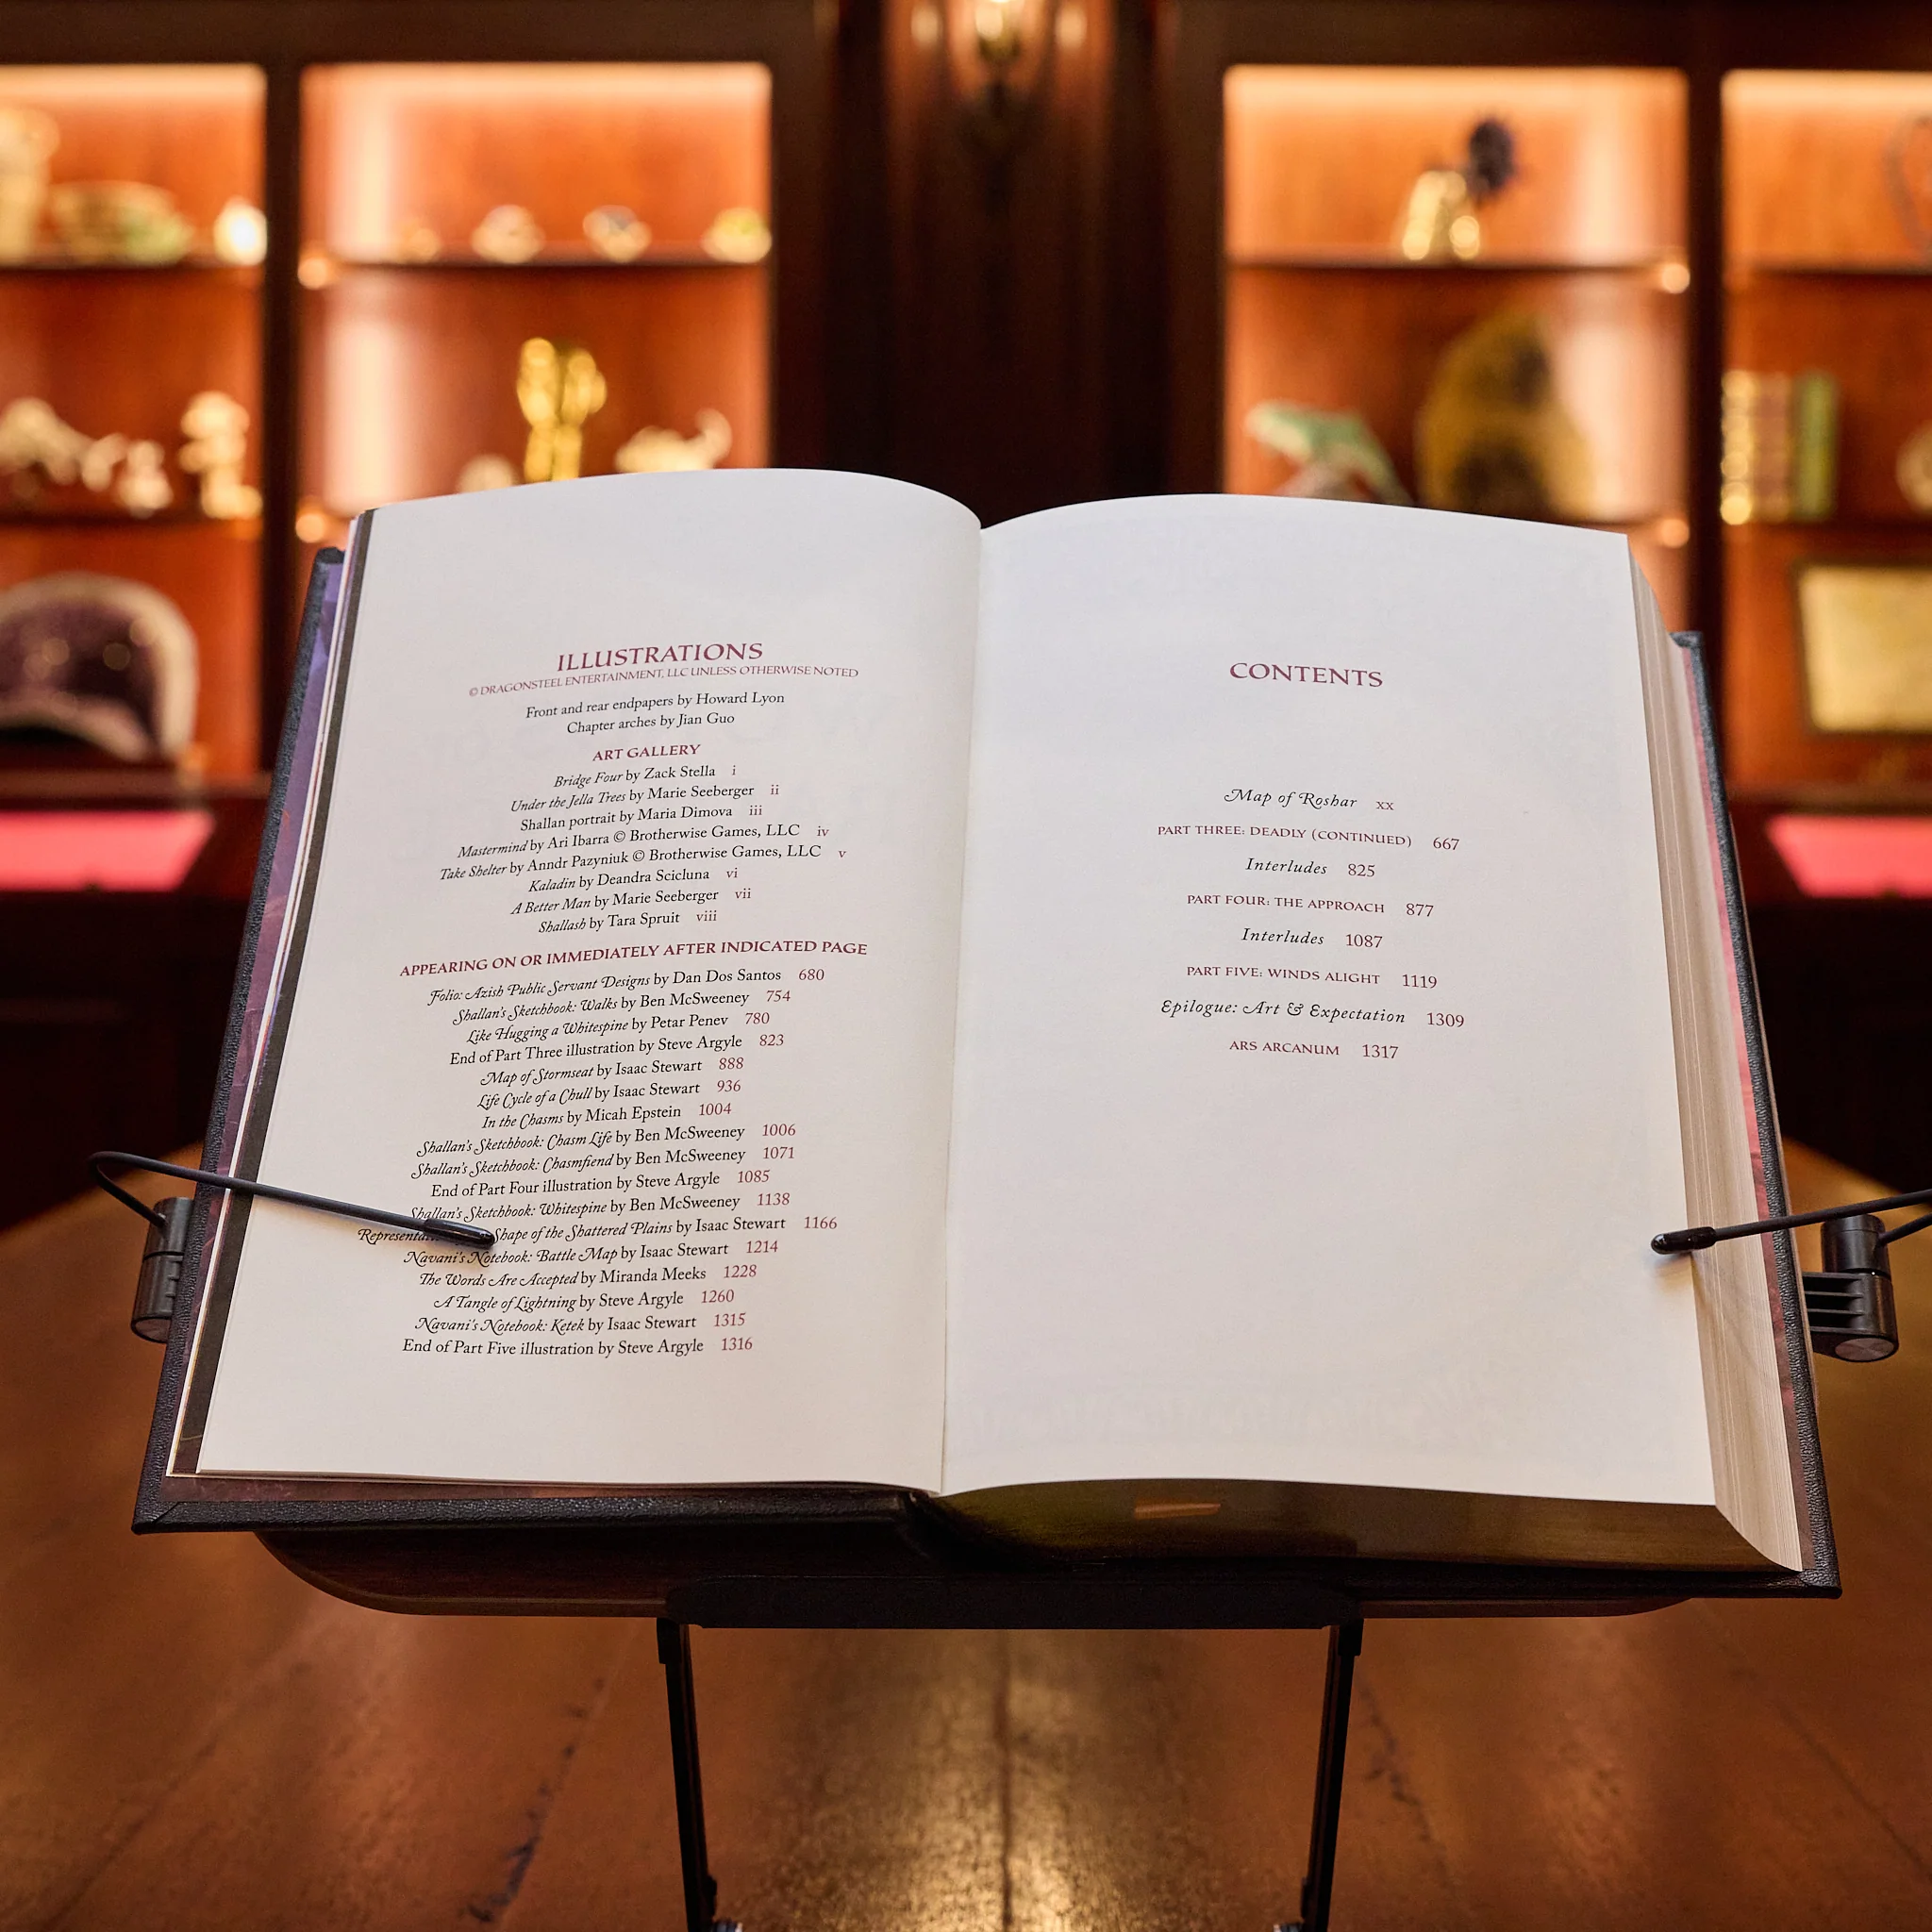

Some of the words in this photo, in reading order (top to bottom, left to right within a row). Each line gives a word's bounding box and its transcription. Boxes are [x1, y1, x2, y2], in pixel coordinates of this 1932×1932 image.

[557, 642, 763, 673] ILLUSTRATIONS
[480, 677, 563, 695] DRAGONSTEEL
[565, 669, 661, 686] ENTERTAINMENT,
[667, 668, 687, 677] LLC
[691, 666, 737, 676] UNLESS
[739, 665, 811, 675] OTHERWISE
[813, 666, 859, 677] NOTED
[1229, 662, 1383, 688] CONTENTS
[525, 706, 558, 719] Front
[560, 701, 583, 715] and
[586, 703, 610, 713] rear
[612, 696, 674, 712] endpapers
[676, 693, 693, 709] by
[695, 691, 748, 705] Howard
[751, 691, 785, 707] Lyon
[566, 721, 616, 736] Chapter
[618, 715, 657, 729] arches
[659, 714, 675, 730] by
[675, 712, 703, 728] Jian
[706, 711, 735, 724] Guo
[591, 748, 625, 762] ART
[626, 743, 702, 758] GALLERY
[553, 774, 592, 790] Bridge
[592, 771, 625, 784] Four
[625, 769, 641, 785] by
[643, 766, 676, 780] Zack
[679, 764, 716, 778] Stella
[731, 764, 736, 776] i
[510, 798, 547, 812] Under
[548, 795, 567, 808] the
[565, 792, 594, 809] Jella
[597, 791, 626, 804] Trees
[629, 789, 645, 805] by
[646, 786, 687, 800] Marie
[691, 784, 755, 800] Seeberger
[770, 784, 779, 795] ii
[1224, 788, 1273, 808] Map
[1277, 791, 1297, 808] of
[1298, 791, 1357, 810] Roshar
[1375, 801, 1394, 811] xx
[520, 816, 566, 832] Shallan
[568, 811, 617, 831] portrait
[619, 809, 635, 825] by
[636, 808, 677, 821] Maria
[679, 806, 733, 819] Dimova
[748, 804, 762, 816] iii
[1158, 824, 1191, 836] PART
[1194, 824, 1245, 836] THREE:
[1250, 826, 1307, 839] DEADLY
[1311, 828, 1412, 848] (CONTINUED)
[1432, 836, 1460, 851] 667
[527, 876, 576, 892] Kaladin
[578, 874, 595, 891] by
[596, 870, 652, 887] Deandra
[655, 868, 710, 882] Scicluna
[725, 867, 738, 878] vi
[1244, 857, 1328, 874] Interludes
[1347, 863, 1375, 877] 825
[1187, 894, 1222, 905] PART
[1224, 894, 1270, 906] FOUR:
[1274, 896, 1304, 908] THE
[1307, 899, 1385, 913] APPROACH
[1406, 902, 1435, 918] 877
[538, 917, 587, 934] Shallash
[589, 916, 605, 933] by
[607, 913, 636, 927] Tara
[640, 911, 681, 929] Spruit
[695, 909, 717, 922] viii
[1241, 927, 1324, 945] Interludes
[1345, 933, 1383, 949] 1087
[399, 958, 489, 977] APPEARING
[491, 956, 517, 970] ON
[520, 954, 542, 967] OR
[546, 944, 660, 965] IMMEDIATELY
[662, 941, 717, 957] AFTER
[720, 940, 818, 954] INDICATED
[821, 941, 868, 956] PAGE
[426, 988, 463, 1007] Folio:
[464, 984, 505, 1001] Azish
[507, 981, 546, 996] Public
[546, 978, 598, 997] Servant
[600, 974, 651, 991] Designs
[653, 972, 670, 989] by
[672, 971, 702, 985] Dan
[705, 969, 733, 983] Dos
[737, 968, 782, 982] Santos
[798, 968, 825, 981] 680
[1187, 966, 1222, 976] PART
[1225, 966, 1263, 977] FIVE:
[1267, 968, 1321, 981] WINDS
[1324, 972, 1381, 985] ALIGHT
[1402, 974, 1438, 990] 1119
[452, 1006, 508, 1026] Shallan's
[507, 1000, 577, 1022] Sketchbook:
[579, 997, 619, 1012] Walks
[621, 995, 638, 1013] by
[639, 994, 666, 1008] Ben
[668, 991, 750, 1008] McSweeney
[766, 989, 791, 1003] 754
[1160, 999, 1238, 1019] Epilogue:
[1241, 1000, 1281, 1015] Art
[1286, 1002, 1305, 1017] &
[1309, 1003, 1406, 1024] Expectation
[1426, 1011, 1465, 1028] 1309
[449, 1050, 476, 1065] End
[478, 1049, 495, 1063] of
[493, 1048, 523, 1062] Part
[525, 1045, 563, 1060] Three
[565, 1041, 635, 1057] illustration
[639, 1039, 656, 1056] by
[658, 1037, 693, 1051] Steve
[695, 1034, 742, 1053] Argyle
[758, 1033, 784, 1047] 823
[1228, 1041, 1257, 1051] ARS
[1262, 1041, 1340, 1056] ARCANUM
[1361, 1043, 1399, 1059] 1317
[480, 1115, 496, 1129] In
[498, 1114, 518, 1128] the
[519, 1112, 565, 1130] Chasms
[566, 1109, 583, 1127] by
[584, 1107, 627, 1123] Micah
[630, 1105, 681, 1124] Epstein
[698, 1102, 732, 1116] 1004
[419, 1272, 442, 1286] The
[444, 1273, 487, 1287] Words
[488, 1273, 518, 1287] Are
[519, 1271, 580, 1291] Accepted
[580, 1270, 597, 1289] by
[598, 1267, 658, 1284] Miranda
[660, 1265, 707, 1281] Meeks
[724, 1263, 758, 1279] 1228
[433, 1295, 457, 1308] A
[456, 1294, 499, 1314] Tangle
[500, 1295, 518, 1314] of
[513, 1295, 577, 1314] Lightning
[579, 1293, 596, 1312] by
[598, 1292, 635, 1307] Steve
[637, 1291, 684, 1310] Argyle
[701, 1289, 735, 1304] 1260
[401, 1338, 433, 1353] End
[435, 1339, 454, 1353] of
[453, 1340, 484, 1355] Part
[486, 1341, 517, 1356] Five
[520, 1341, 594, 1356] illustration
[597, 1341, 615, 1359] by
[617, 1340, 654, 1355] Steve
[657, 1338, 704, 1357] Argyle
[721, 1337, 753, 1351] 1316
